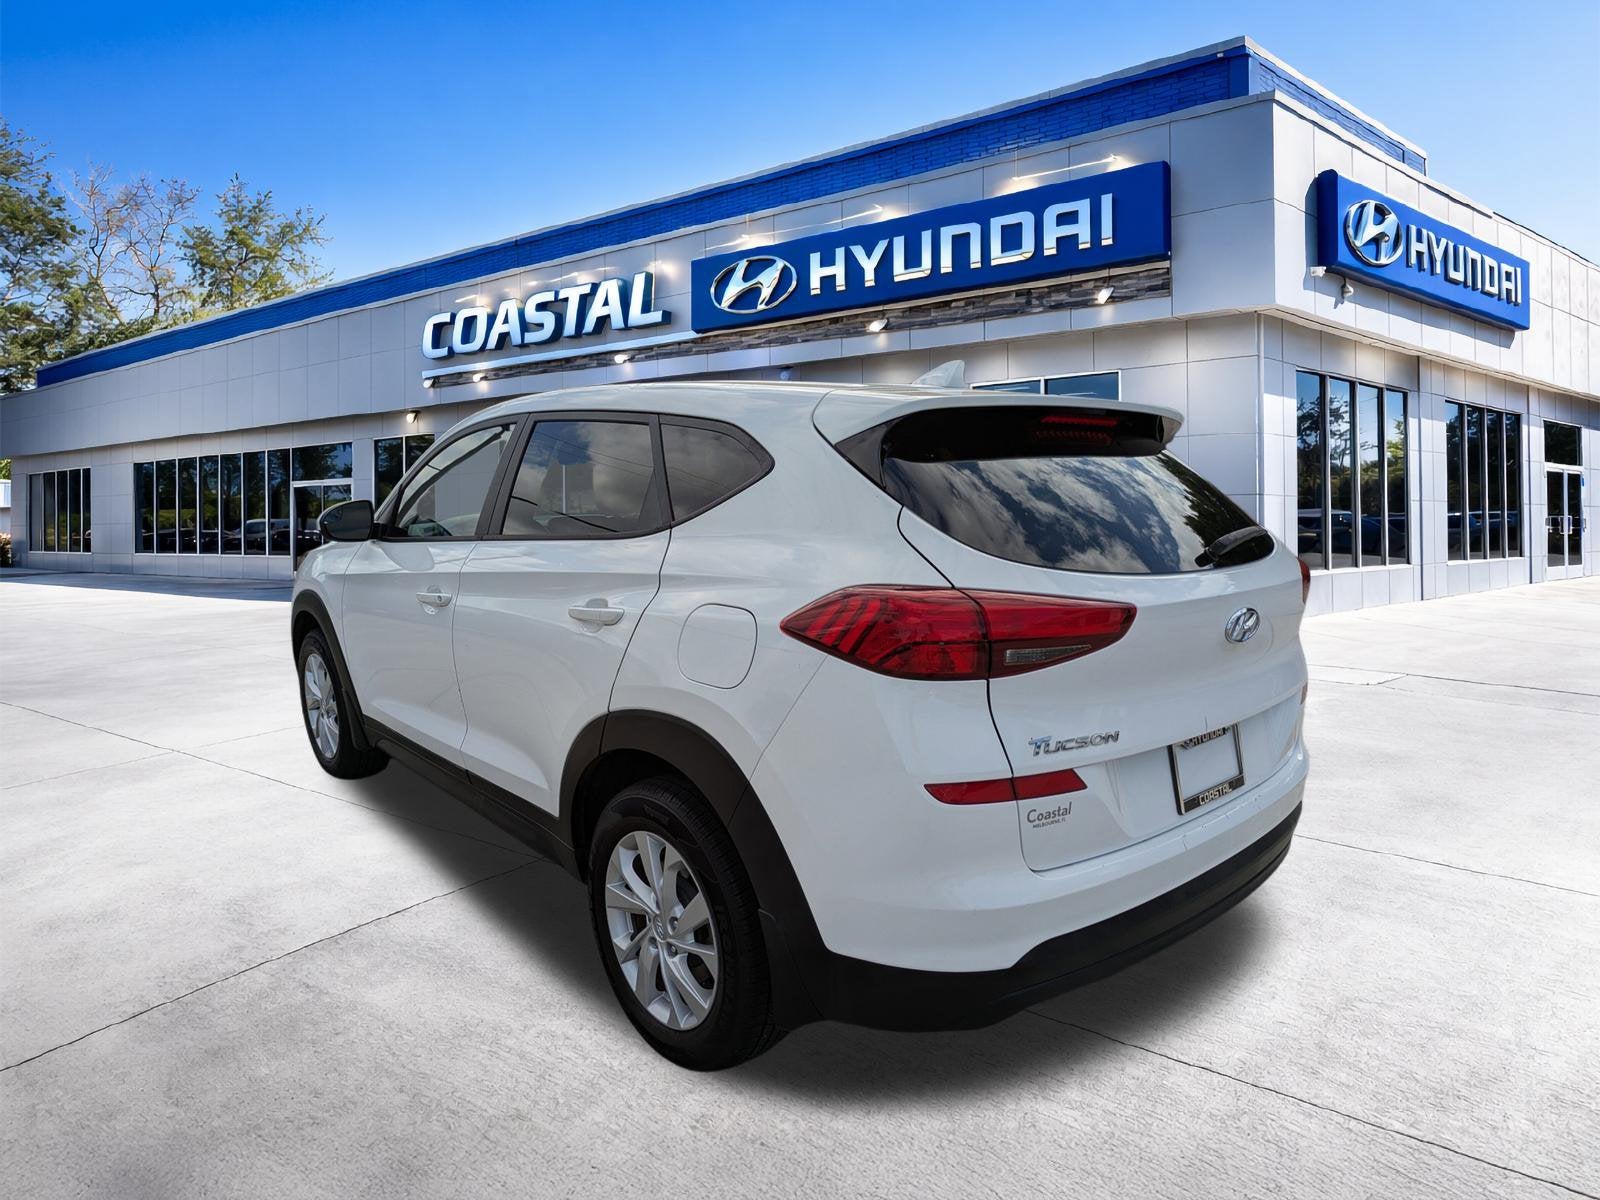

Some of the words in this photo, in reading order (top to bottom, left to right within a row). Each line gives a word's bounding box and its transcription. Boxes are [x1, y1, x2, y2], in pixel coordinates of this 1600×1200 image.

[809, 192, 1114, 295] HYUNDAI
[1406, 223, 1522, 306] HYUNDAI
[421, 271, 671, 360] COASTAL
[1028, 730, 1120, 757] TUCSON
[1027, 801, 1072, 823] Coastal
[1199, 783, 1233, 806] COASTAL
